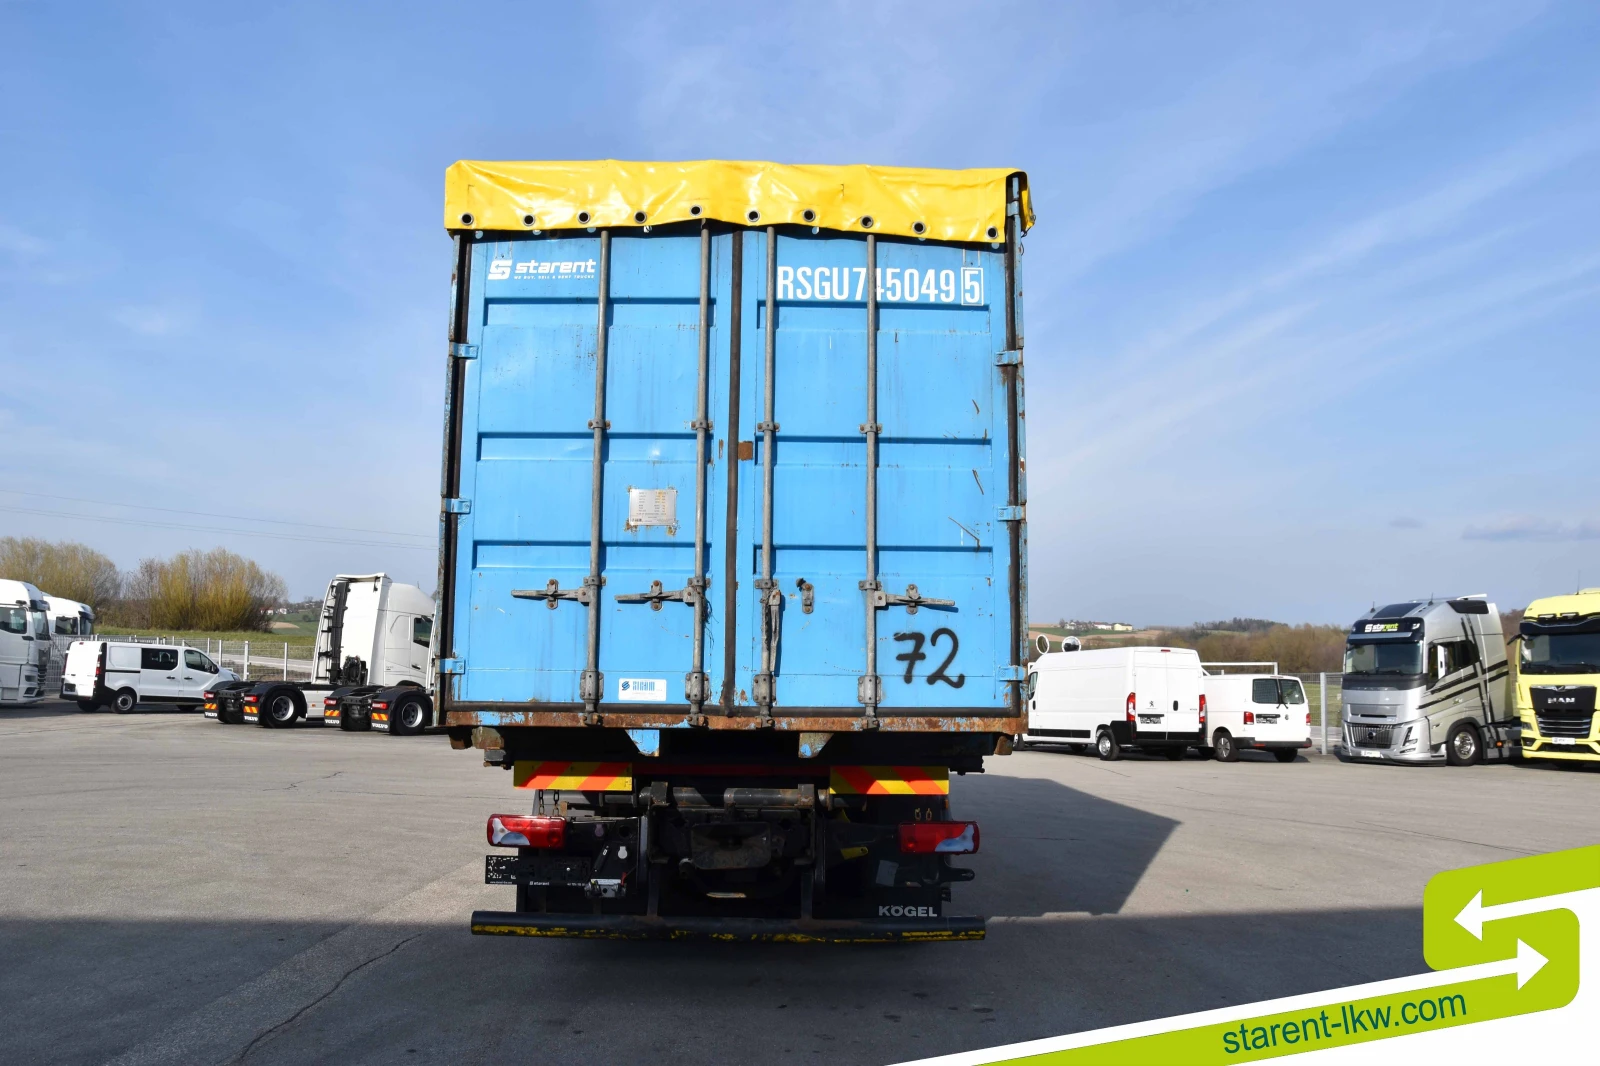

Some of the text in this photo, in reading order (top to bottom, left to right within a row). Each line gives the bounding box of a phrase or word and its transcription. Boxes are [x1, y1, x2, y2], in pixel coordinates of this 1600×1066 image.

[515, 259, 597, 274] starent
[964, 269, 980, 304] 5
[893, 628, 965, 688] 72
[878, 904, 938, 917] KÖGEL
